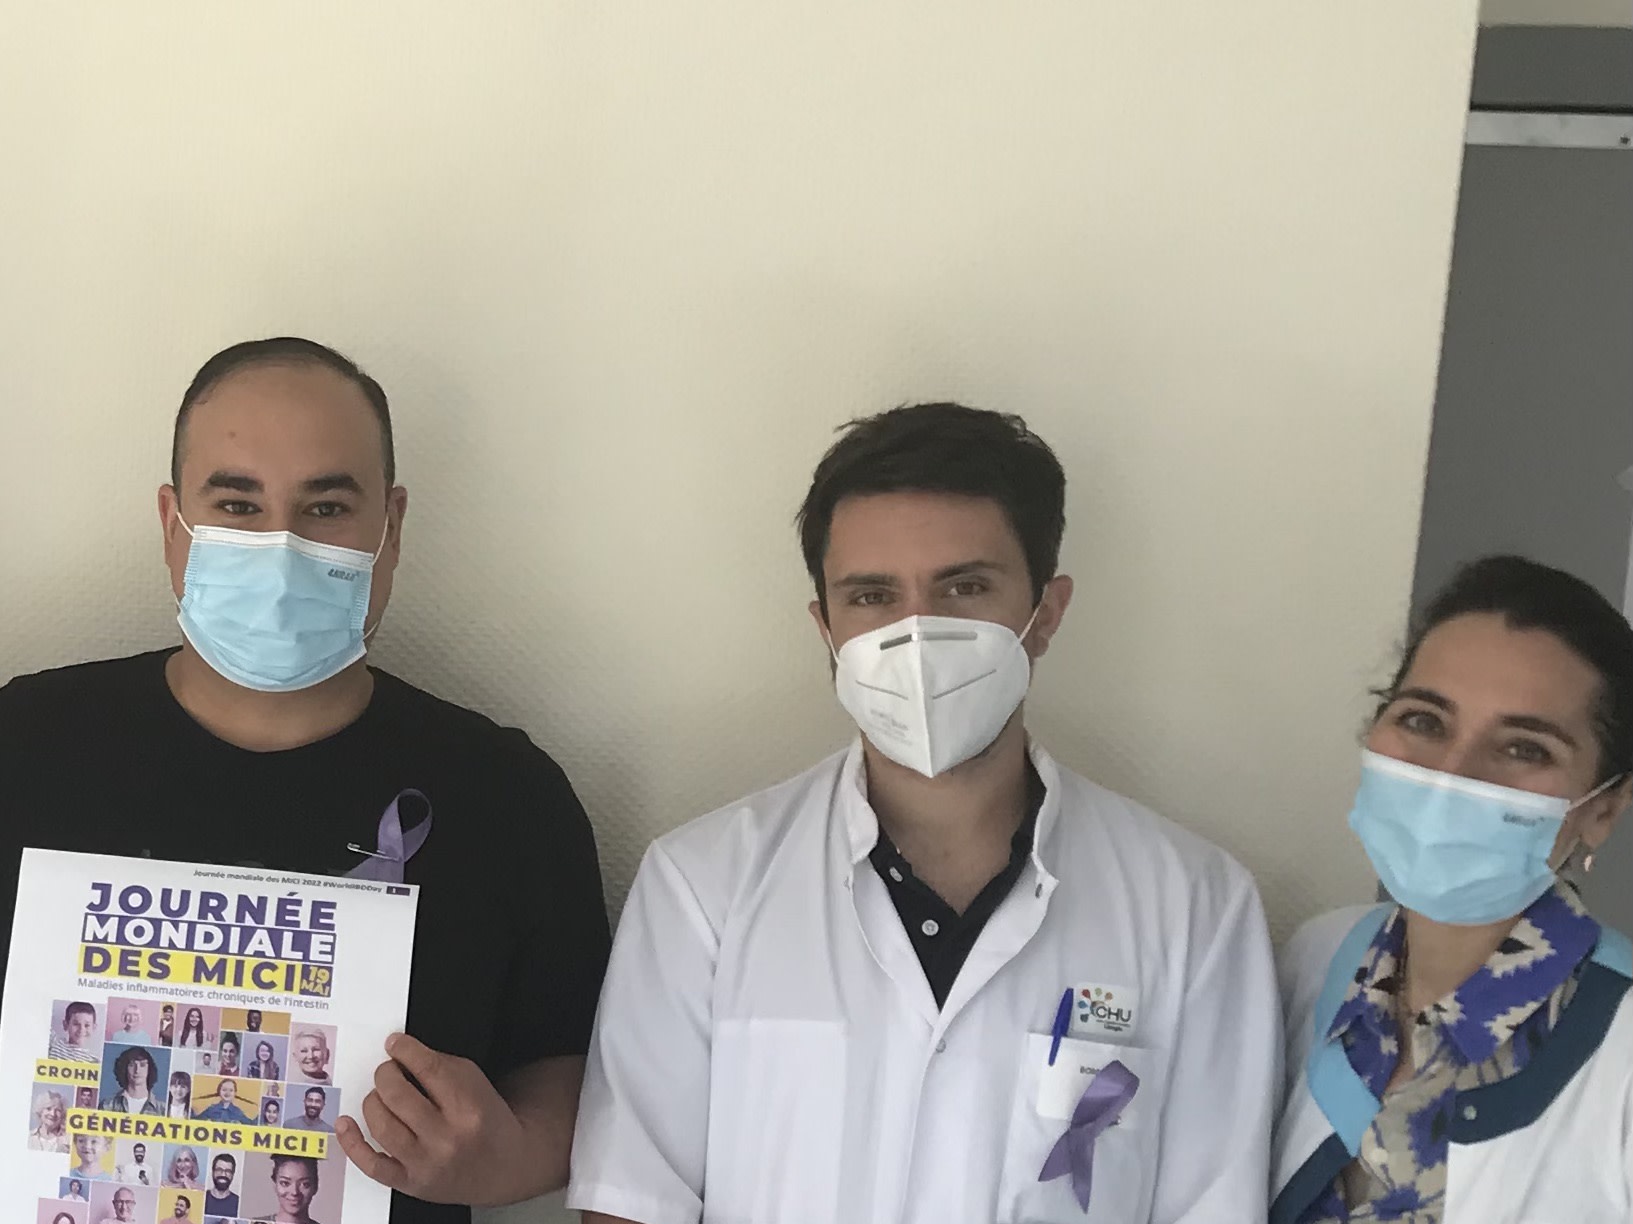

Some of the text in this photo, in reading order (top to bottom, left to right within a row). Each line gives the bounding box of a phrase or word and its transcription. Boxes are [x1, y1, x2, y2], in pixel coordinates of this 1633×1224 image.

[86, 882, 337, 931] JOURNÉE
[84, 914, 334, 962] MONDIALE
[82, 946, 296, 992] DES MICI
[309, 966, 330, 984] 19
[78, 978, 124, 990] Maladies
[126, 982, 204, 999] inflammatoires
[207, 990, 265, 1005] chroniques
[268, 995, 281, 1006] de
[301, 979, 330, 996] MAI
[1096, 1005, 1132, 1022] CHU
[36, 1065, 99, 1081] CROHN
[69, 1112, 243, 1145] GÉNÉRATIONS
[252, 1132, 308, 1152] MICI
